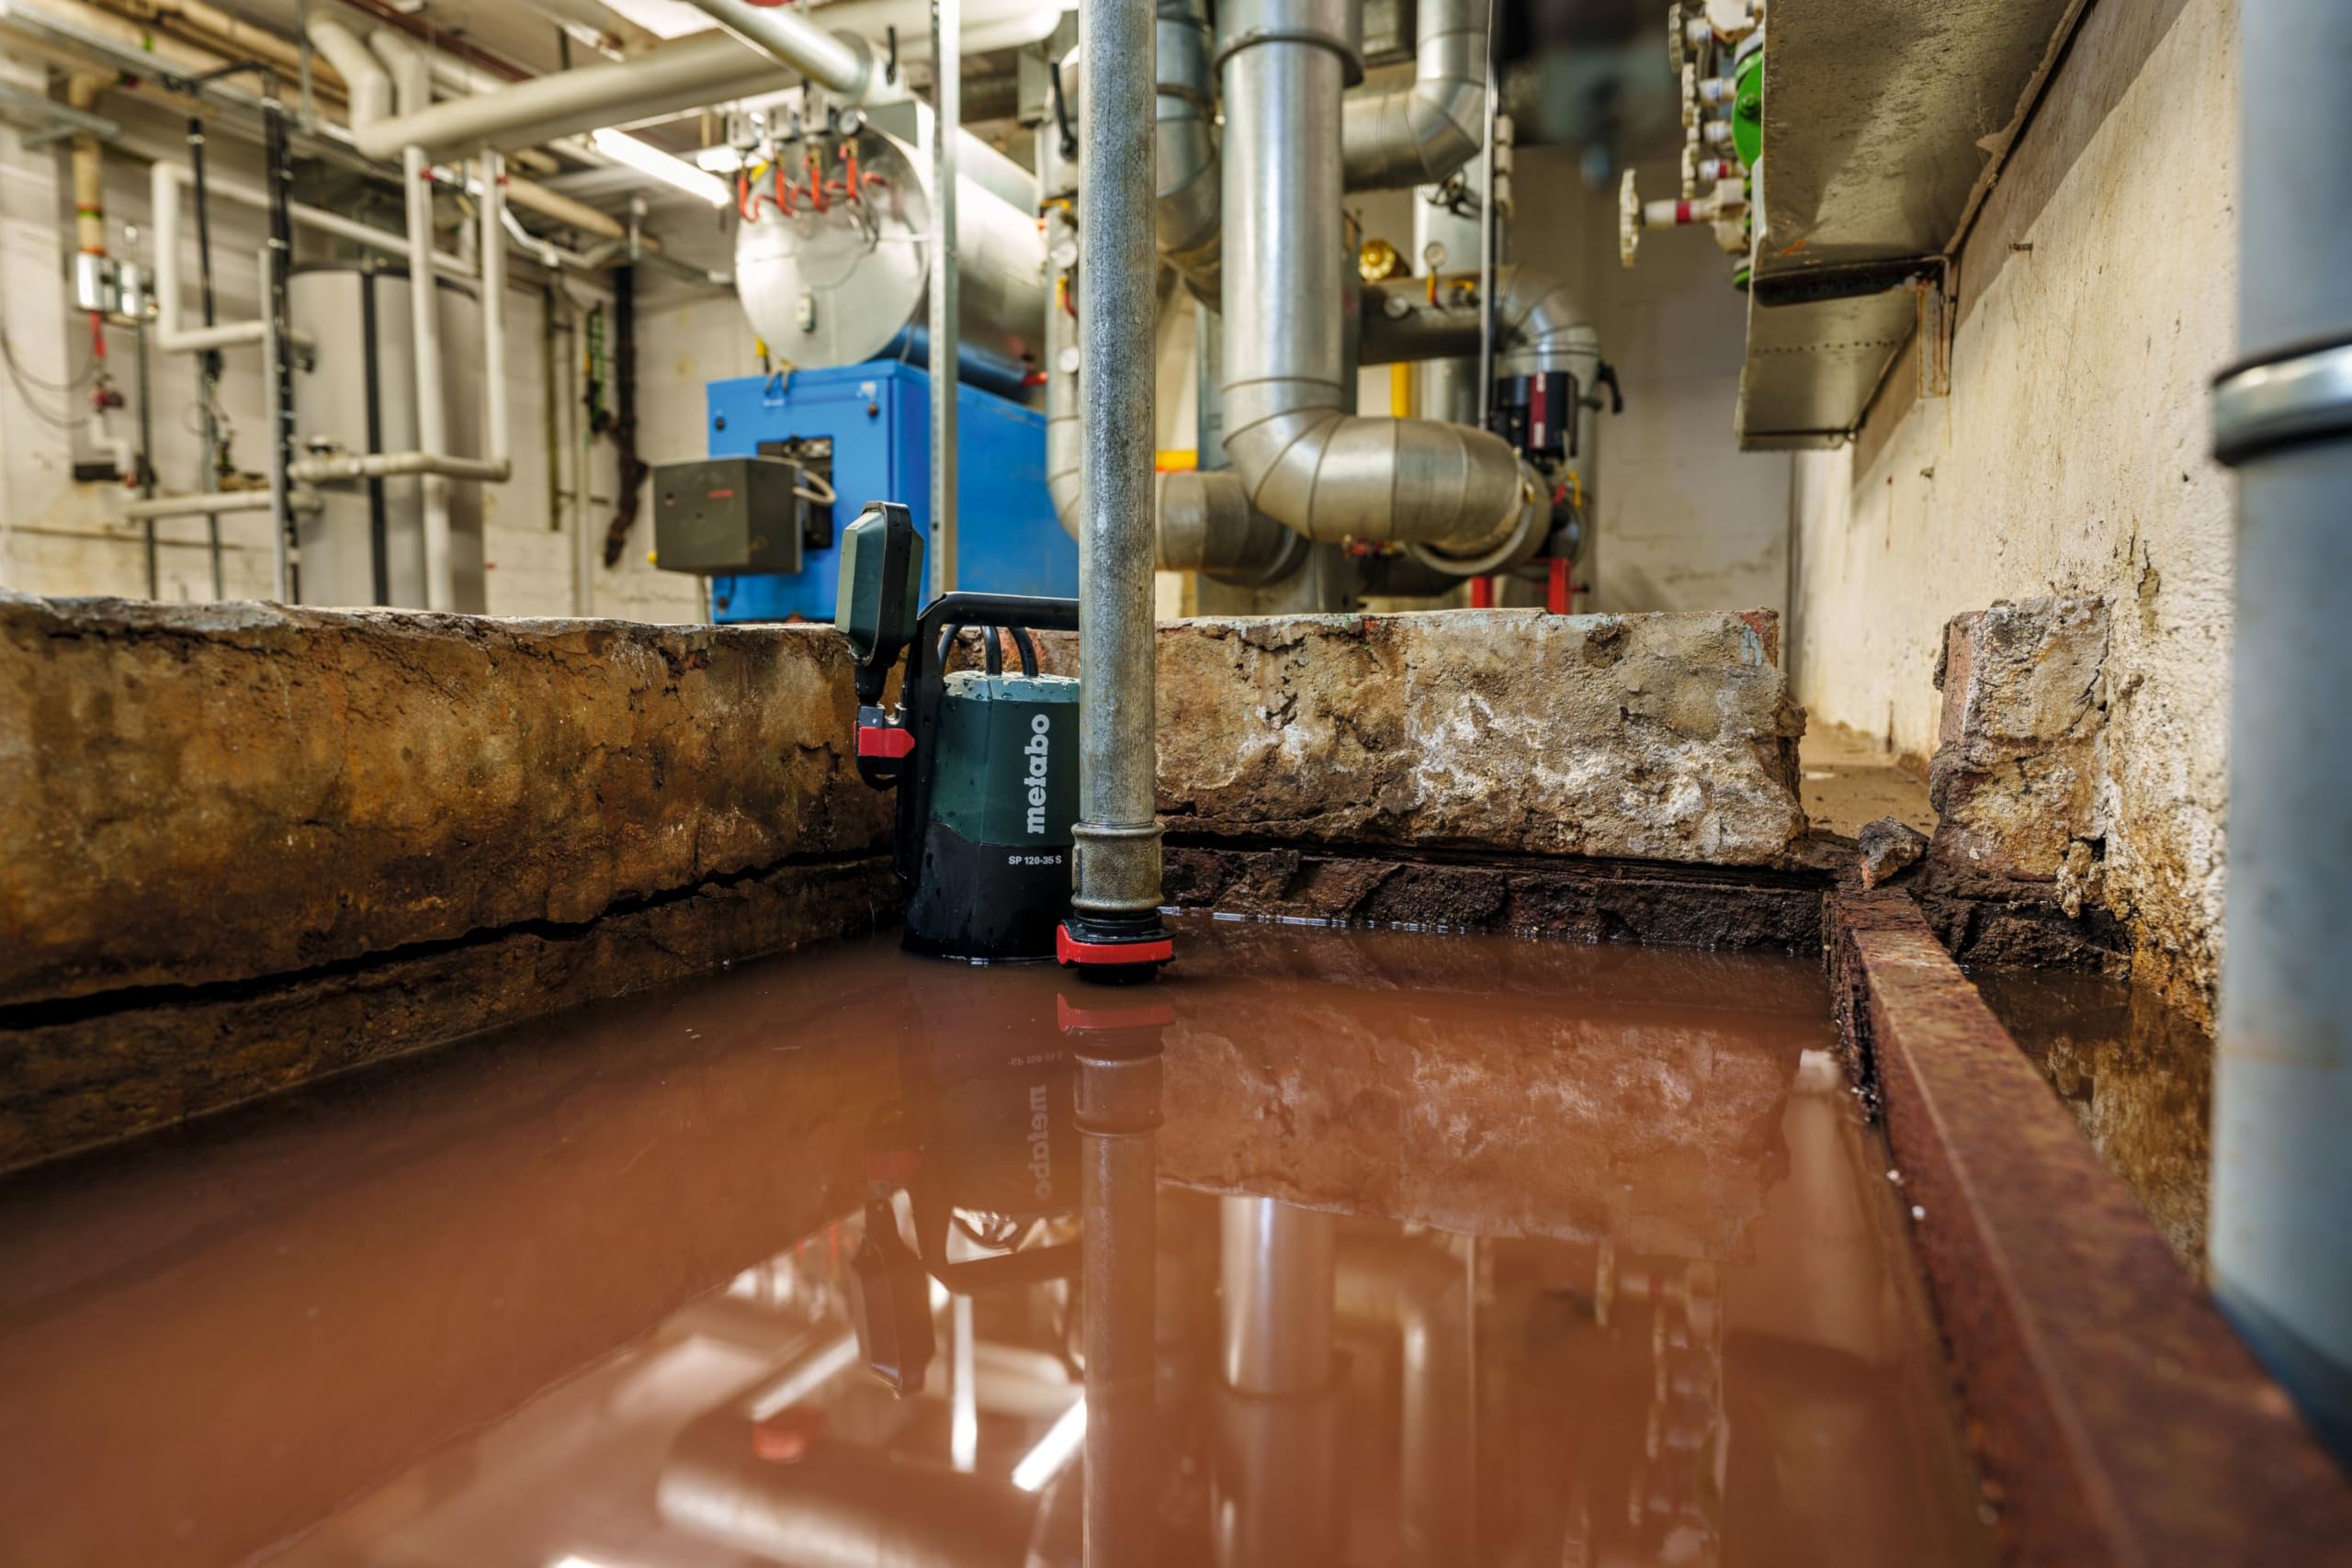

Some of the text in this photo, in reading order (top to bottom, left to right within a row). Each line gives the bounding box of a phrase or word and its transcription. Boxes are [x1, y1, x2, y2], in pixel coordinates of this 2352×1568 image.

[1023, 714, 1050, 834] metabo
[1008, 854, 1062, 865] SP 120-35 S
